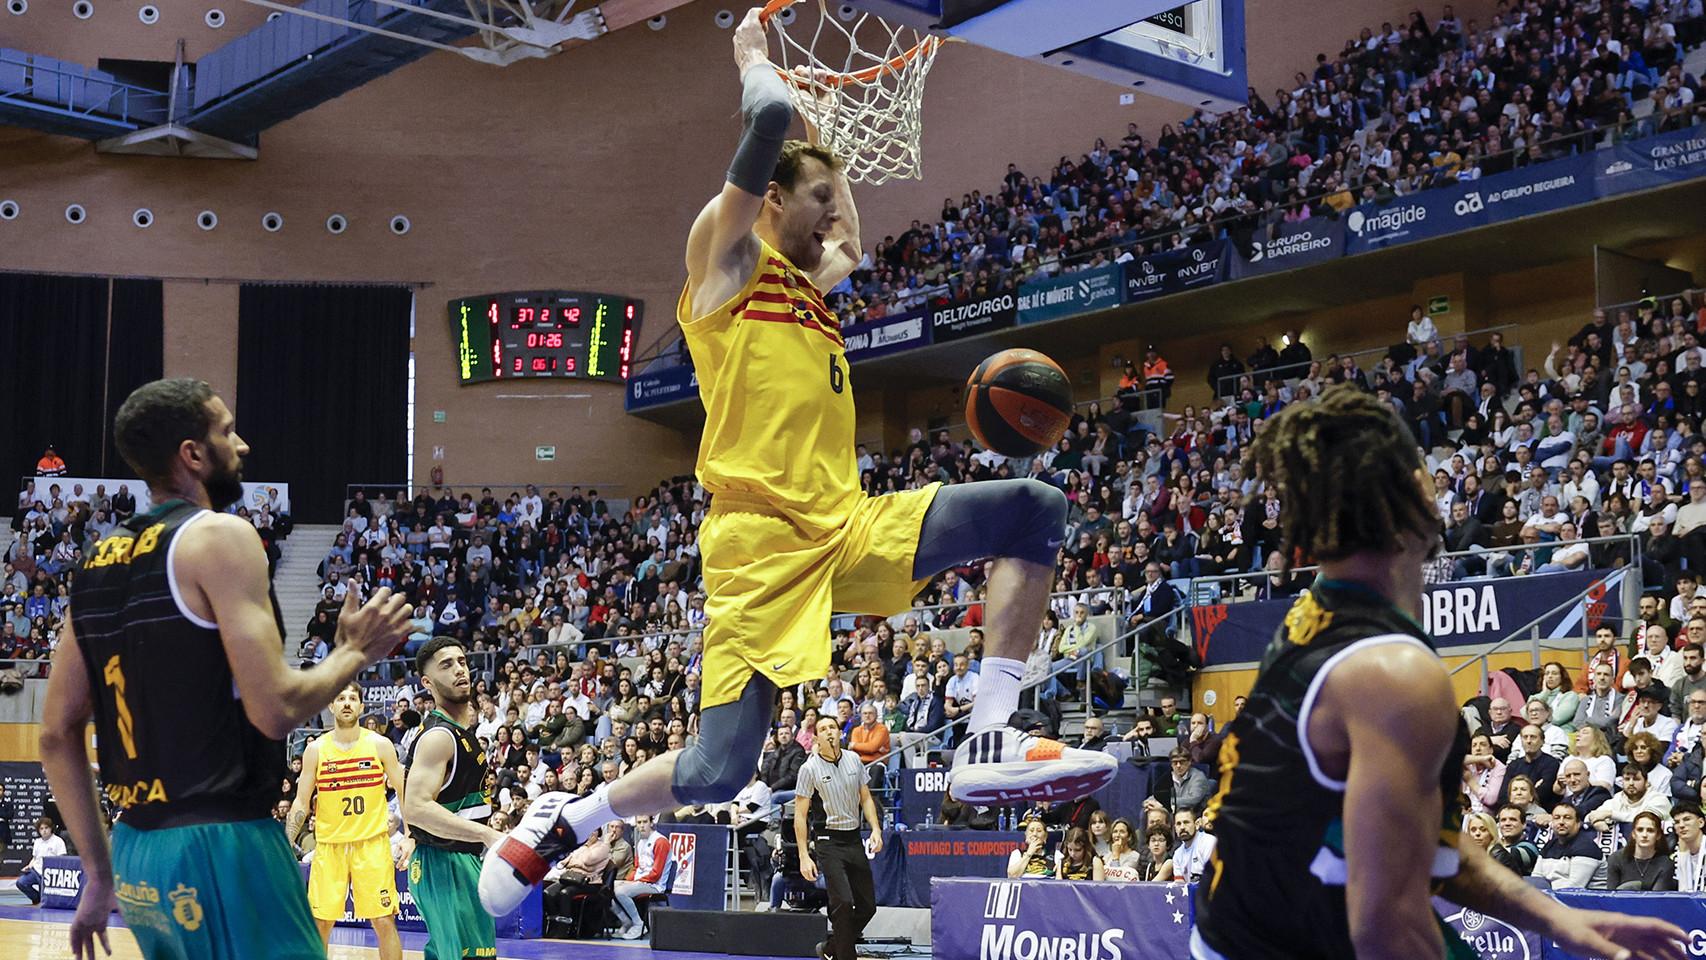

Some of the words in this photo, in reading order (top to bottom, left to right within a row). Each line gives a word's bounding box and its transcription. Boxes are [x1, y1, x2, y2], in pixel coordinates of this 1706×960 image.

[1651, 143, 1684, 158] GRAN
[1654, 156, 1677, 171] LOS
[1487, 190, 1501, 203] AD
[1502, 184, 1533, 200] GRUPO
[1533, 175, 1575, 193] REGUEIRA
[1366, 205, 1426, 231] magide
[1266, 231, 1312, 249] GRUPO
[1267, 237, 1331, 259] BARREIRO
[518, 308, 535, 322] 37
[541, 309, 549, 321] 2
[564, 308, 580, 322] 42
[527, 333, 562, 347] 01:26
[844, 333, 869, 352] ZONA
[514, 358, 522, 370] 3
[566, 358, 575, 370] 5
[830, 353, 843, 394] 6
[104, 655, 137, 759] 1
[342, 795, 365, 816] 20
[908, 841, 951, 856] SANTIAGO
[953, 841, 965, 856] DE
[43, 867, 82, 889] STARK
[980, 924, 1125, 960] MONBUS
